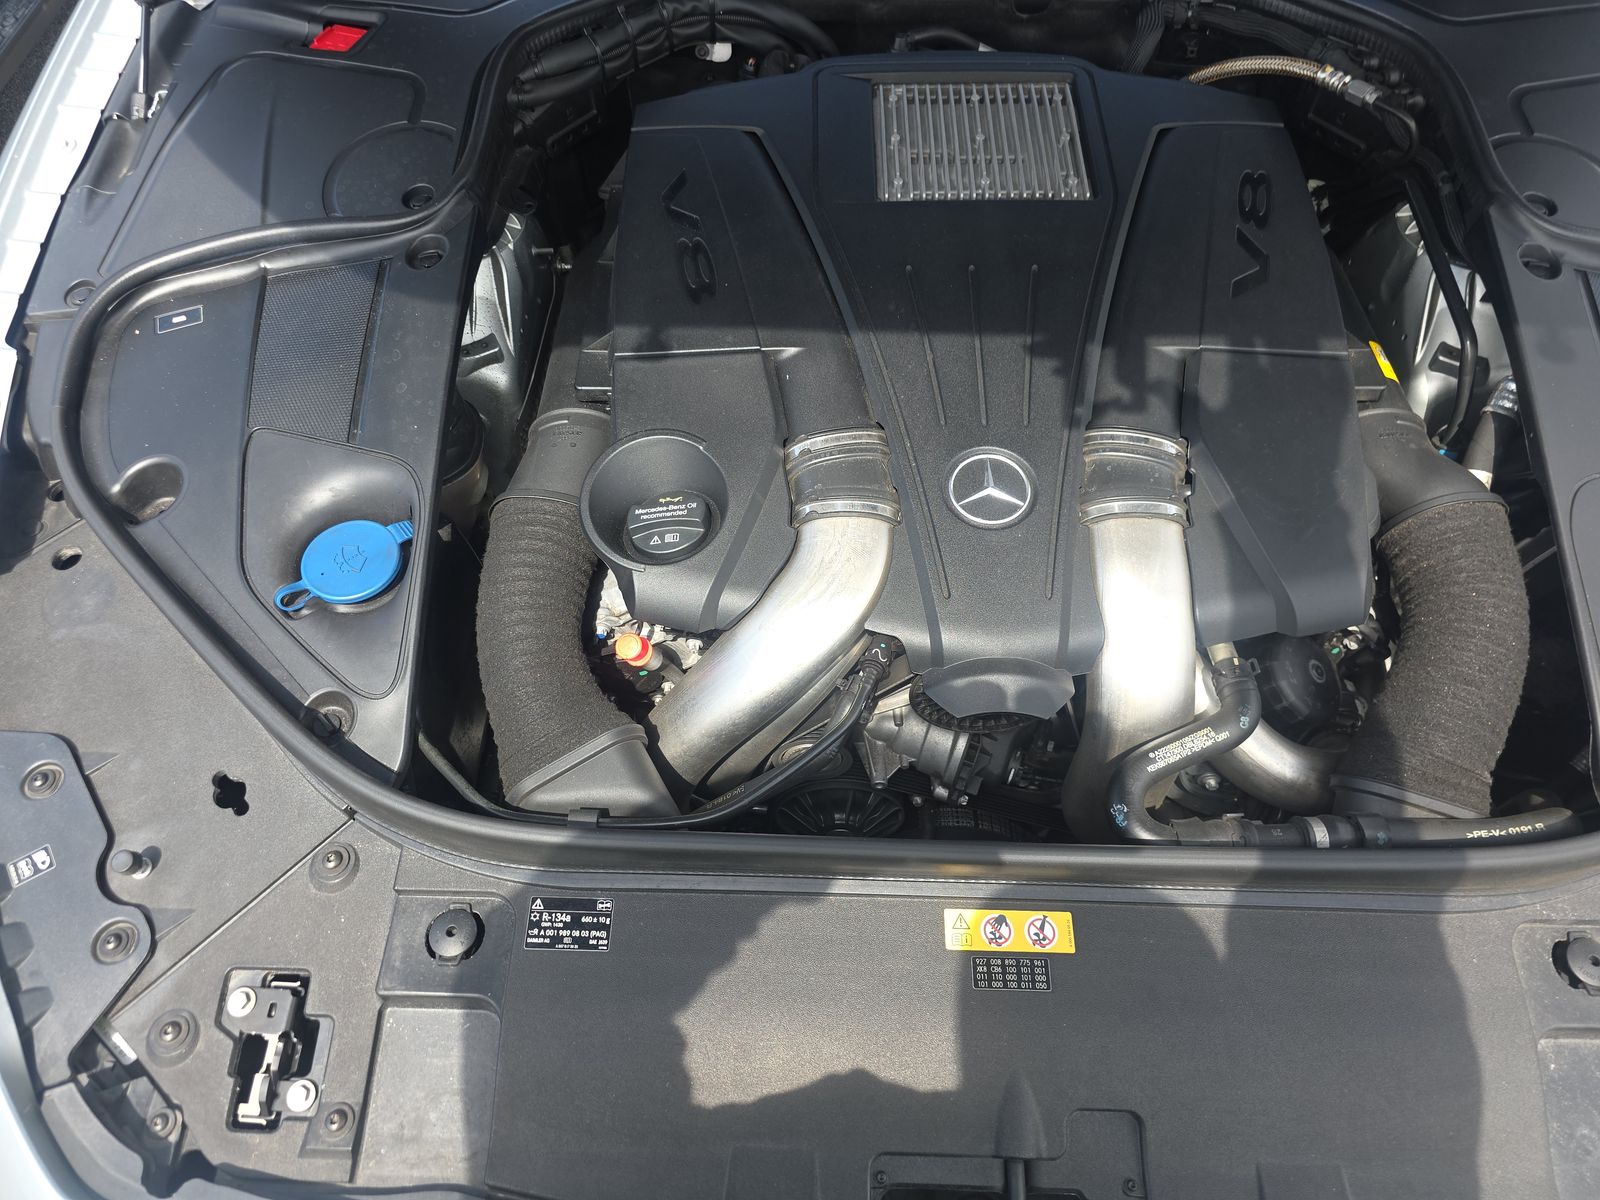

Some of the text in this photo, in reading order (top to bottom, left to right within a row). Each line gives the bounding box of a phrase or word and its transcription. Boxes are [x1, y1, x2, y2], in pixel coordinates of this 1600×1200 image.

[661, 168, 718, 303] V8
[1229, 169, 1271, 300] V8
[635, 504, 686, 515] Mercedes-Benz
[640, 510, 687, 520] recommended
[1466, 828, 1507, 839] >PE-V<
[542, 912, 571, 922] R-134a
[590, 930, 607, 938] (PAG)
